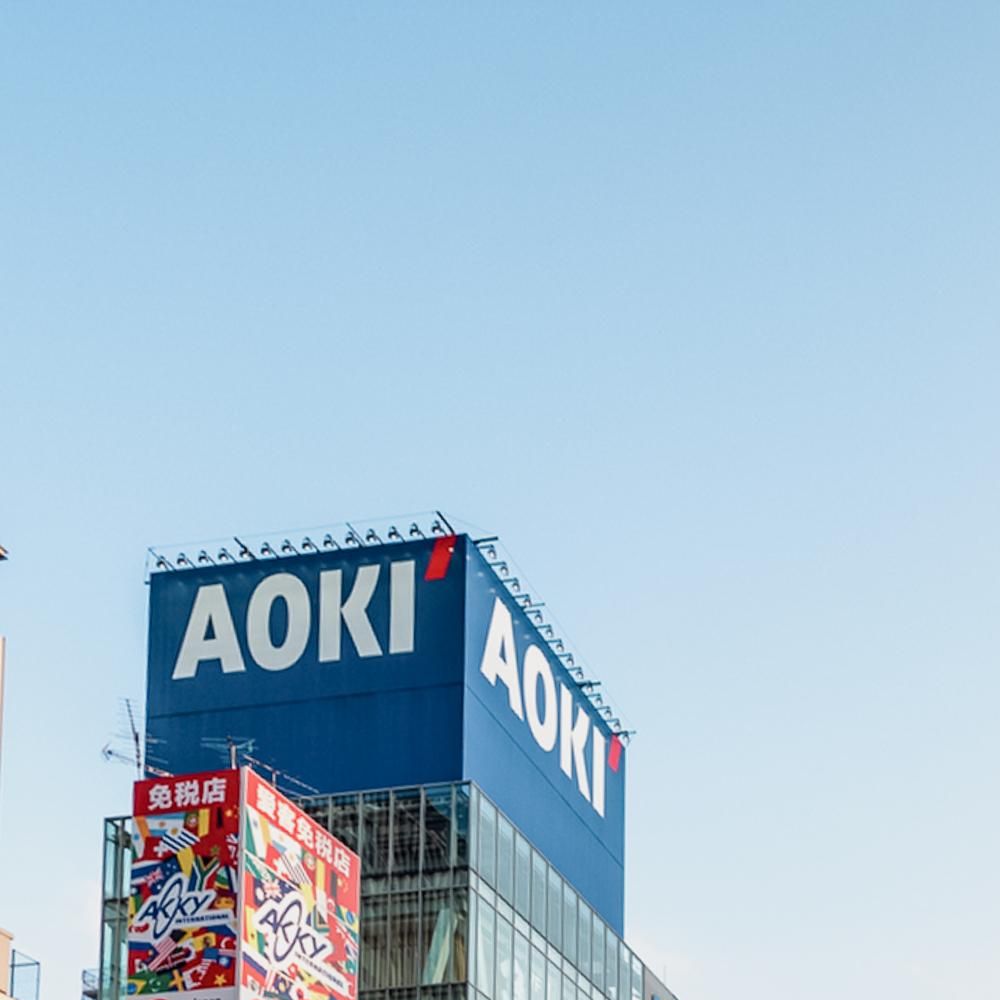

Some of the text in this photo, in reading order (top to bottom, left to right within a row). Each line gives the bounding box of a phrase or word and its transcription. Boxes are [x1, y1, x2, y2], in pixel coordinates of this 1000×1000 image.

[172, 560, 416, 680] AOKI
[480, 596, 605, 818] AOKI
[148, 778, 227, 809] 免税店
[139, 878, 214, 939] AKKY
[174, 912, 230, 925] INTERNATIONAL
[259, 899, 327, 962] AKKY
